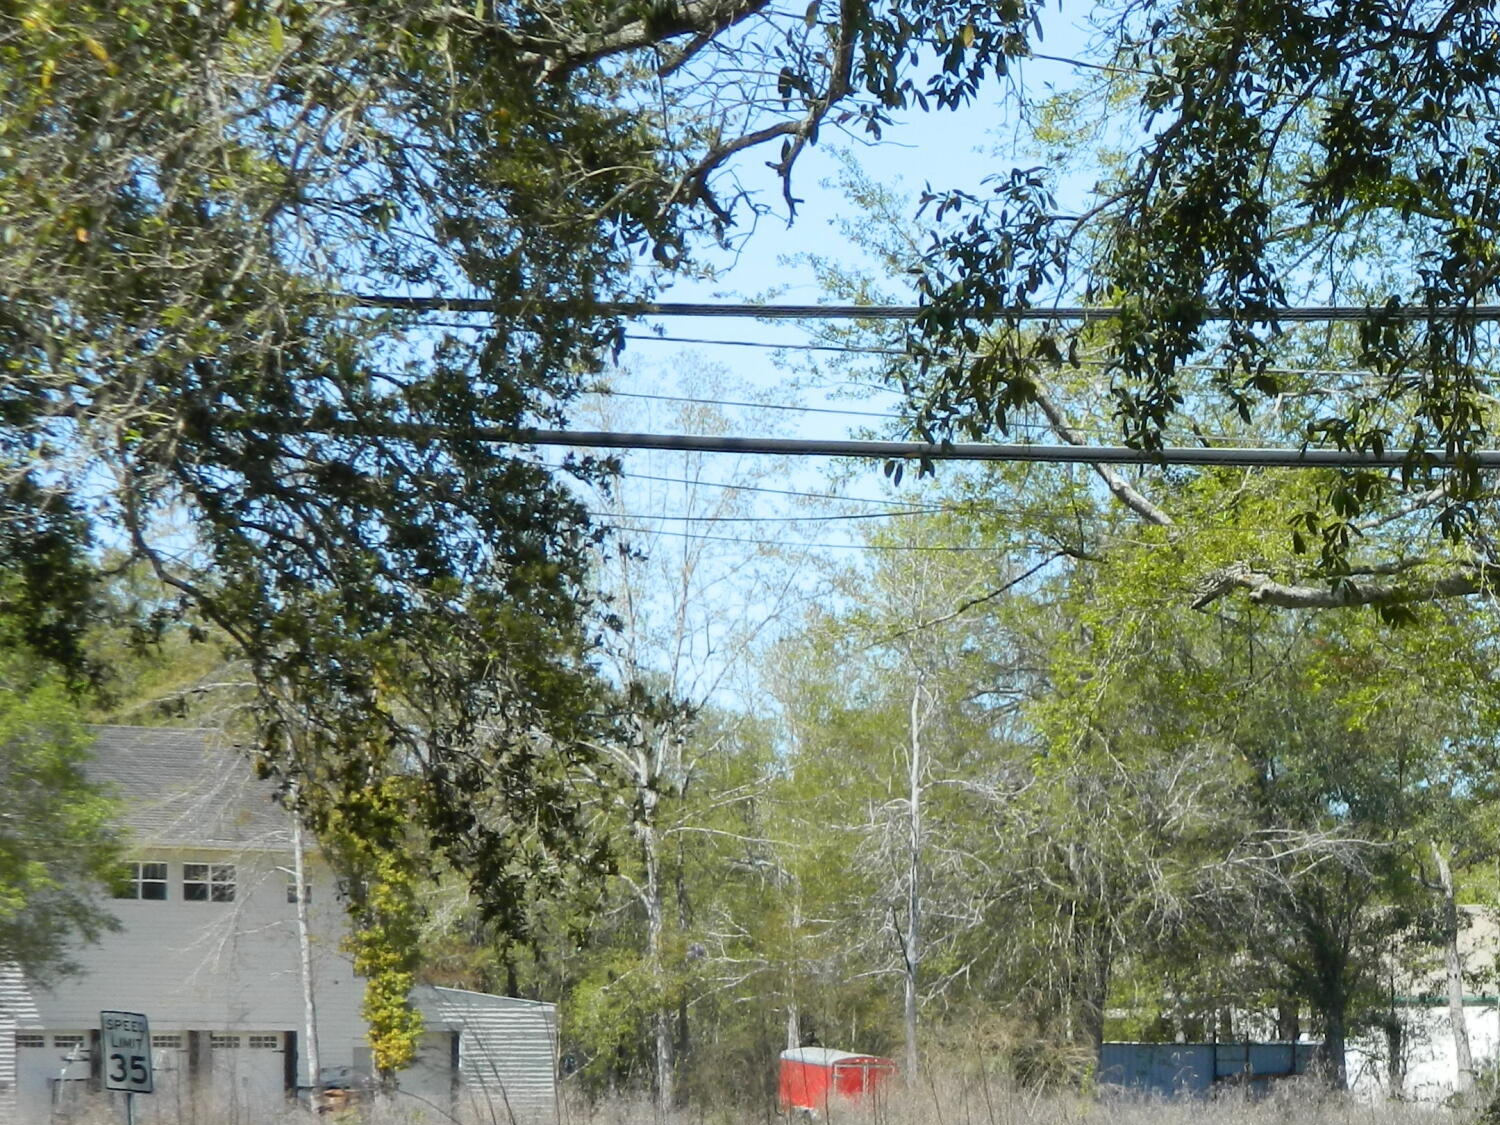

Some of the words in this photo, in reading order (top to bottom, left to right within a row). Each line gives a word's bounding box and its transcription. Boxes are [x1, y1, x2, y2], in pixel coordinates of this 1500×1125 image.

[106, 1019, 146, 1033] SPEED
[112, 1036, 143, 1051] LIMIT
[110, 1053, 148, 1085] 35
